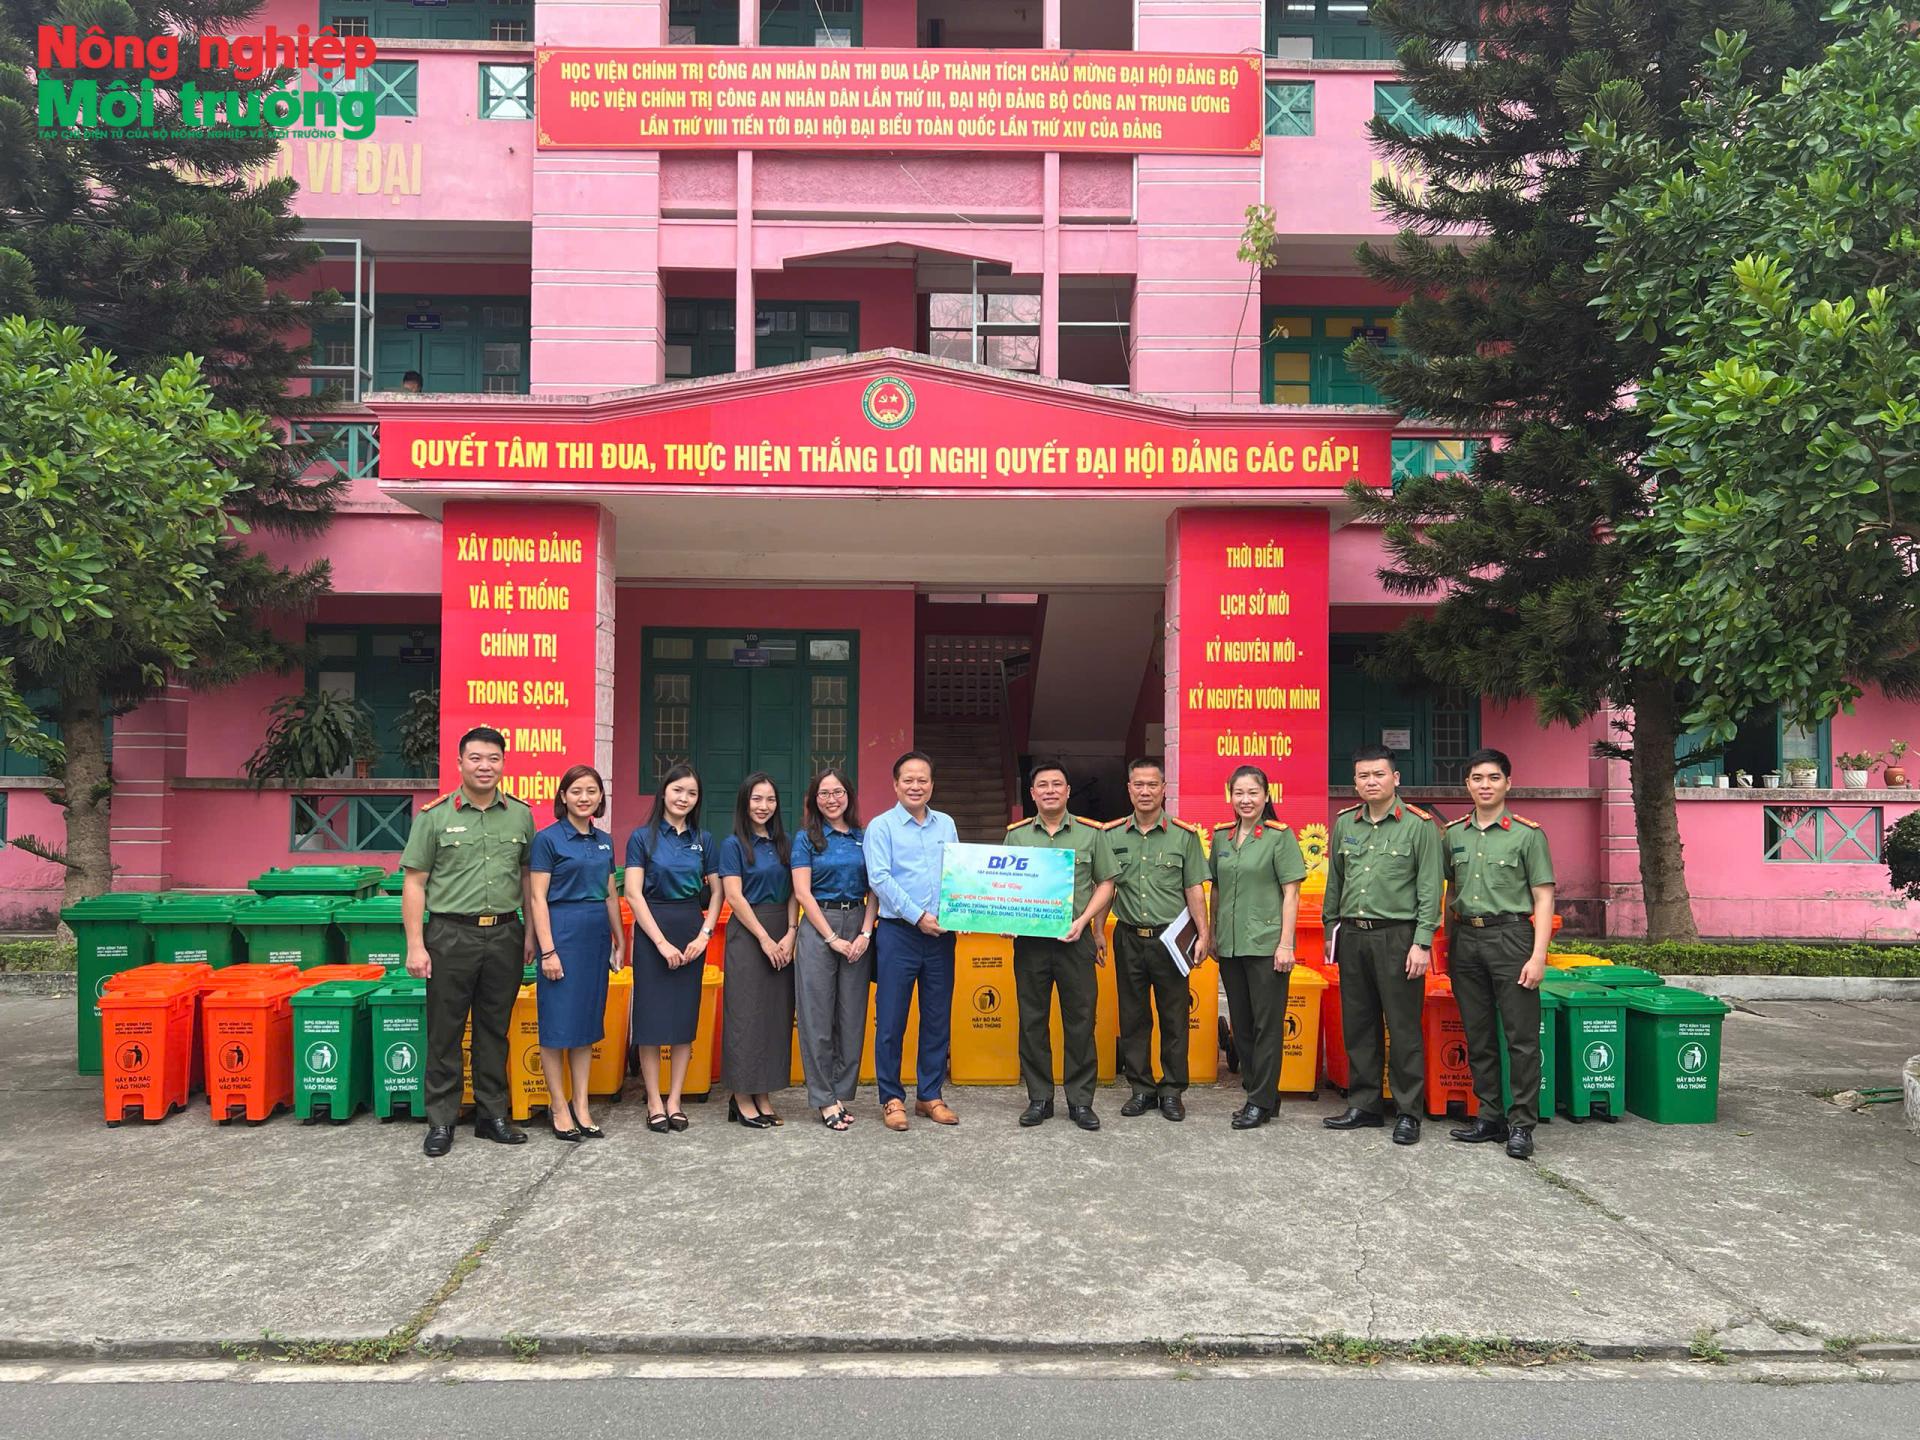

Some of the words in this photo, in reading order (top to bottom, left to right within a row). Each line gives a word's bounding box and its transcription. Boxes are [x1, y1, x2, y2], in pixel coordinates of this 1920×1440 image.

[561, 62, 590, 83] HỌC
[594, 60, 628, 83] VIỆN
[632, 60, 677, 80] CHÍNH
[680, 63, 703, 83] TRỊ
[708, 60, 747, 80] CÔNG
[751, 63, 772, 80] AN
[776, 60, 816, 80] NHÂN
[820, 60, 850, 80] DÂN
[854, 63, 876, 80] THI
[880, 63, 909, 80] ĐUA
[912, 60, 940, 84] LẬP
[944, 60, 991, 80] THÀNH
[995, 61, 1026, 81] TÍCH
[1031, 62, 1069, 82] CHÀO
[1073, 62, 1116, 83] MỪNG
[1120, 66, 1144, 87] ĐẠI
[1148, 64, 1172, 88] HỘI
[1176, 63, 1215, 85] ĐẢNG
[1220, 66, 1238, 89] BỘ
[570, 91, 599, 111] HỌC
[604, 88, 637, 111] VIỆN
[641, 88, 686, 108] CHÍNH
[690, 91, 712, 111] TRỊ
[716, 88, 756, 107] CÔNG
[760, 91, 781, 107] AN
[785, 87, 826, 107] NHÂN
[830, 88, 860, 107] DÂN
[864, 85, 892, 108] LẦN
[895, 88, 924, 108] THỨ
[927, 91, 945, 110] III,
[949, 91, 974, 112] ĐẠI
[978, 88, 1002, 112] HỘI
[1005, 87, 1045, 109] ĐẢNG
[1049, 90, 1068, 113] BỘ
[1072, 90, 1112, 110] CÔNG
[1116, 94, 1136, 111] AN
[1140, 94, 1187, 112] TRUNG
[1191, 95, 1230, 113] ƯƠNG
[640, 114, 668, 136] LẦN
[672, 115, 702, 135] THỨ
[704, 118, 727, 135] VIII
[731, 113, 764, 135] TIẾN
[767, 115, 790, 135] TỚI
[794, 118, 818, 138] ĐẠI
[822, 115, 846, 138] HỘI
[850, 118, 875, 139] ĐẠI
[879, 112, 912, 135] BIỂU
[916, 116, 953, 136] TOÀN
[958, 114, 996, 138] QUỐC
[1000, 114, 1028, 136] LẦN
[1032, 117, 1060, 137] THỨ
[1063, 121, 1086, 138] XIV
[1090, 116, 1119, 138] CỦA
[1122, 117, 1162, 139] ĐẢNG
[357, 142, 422, 204] ĐẠI
[411, 432, 488, 468] QUYẾT
[495, 436, 548, 468] TÂM
[556, 442, 593, 468] THI
[601, 443, 656, 473] ĐUA,
[664, 442, 726, 476] THỰC
[734, 440, 790, 478] HIỆN
[798, 436, 878, 473] THẮNG
[886, 444, 922, 479] LỢI
[930, 447, 987, 479] NGHỊ
[995, 439, 1070, 476] QUYẾT
[1076, 447, 1116, 479] ĐẠI
[1124, 442, 1164, 479] HỘI
[1171, 438, 1238, 473] ĐẢNG
[1246, 441, 1294, 473] CÁC
[1302, 437, 1358, 472] CẤP!
[457, 532, 488, 561] XÂY
[492, 536, 535, 567] DỰNG
[539, 531, 582, 563] ĐẢNG
[1226, 542, 1252, 568] THỜI
[1254, 539, 1284, 568] ĐIỂM
[469, 580, 490, 609] VÀ
[494, 581, 514, 615] HỆ
[518, 578, 569, 610] THỐNG
[1220, 594, 1246, 620] LỊCH
[1248, 588, 1266, 616] SỬ
[1267, 590, 1290, 615] MỚI
[480, 628, 528, 657] CHÍNH
[533, 633, 557, 663] TRỊ
[1206, 635, 1222, 662] KỶ
[1224, 637, 1270, 662] NGUYÊN
[1273, 637, 1295, 662] MỚI
[467, 680, 518, 704] TRONG
[523, 680, 569, 710] SẠCH,
[1189, 682, 1204, 709] KỶ
[1206, 684, 1253, 710] NGUYÊN
[1255, 686, 1286, 710] VƯƠN
[1289, 684, 1320, 710] MÌNH
[515, 728, 566, 757] MẠNH,
[1217, 728, 1240, 756] CỦA
[1243, 731, 1267, 756] DÂN
[1270, 732, 1292, 761] TỘC
[988, 854, 1030, 870] BPG
